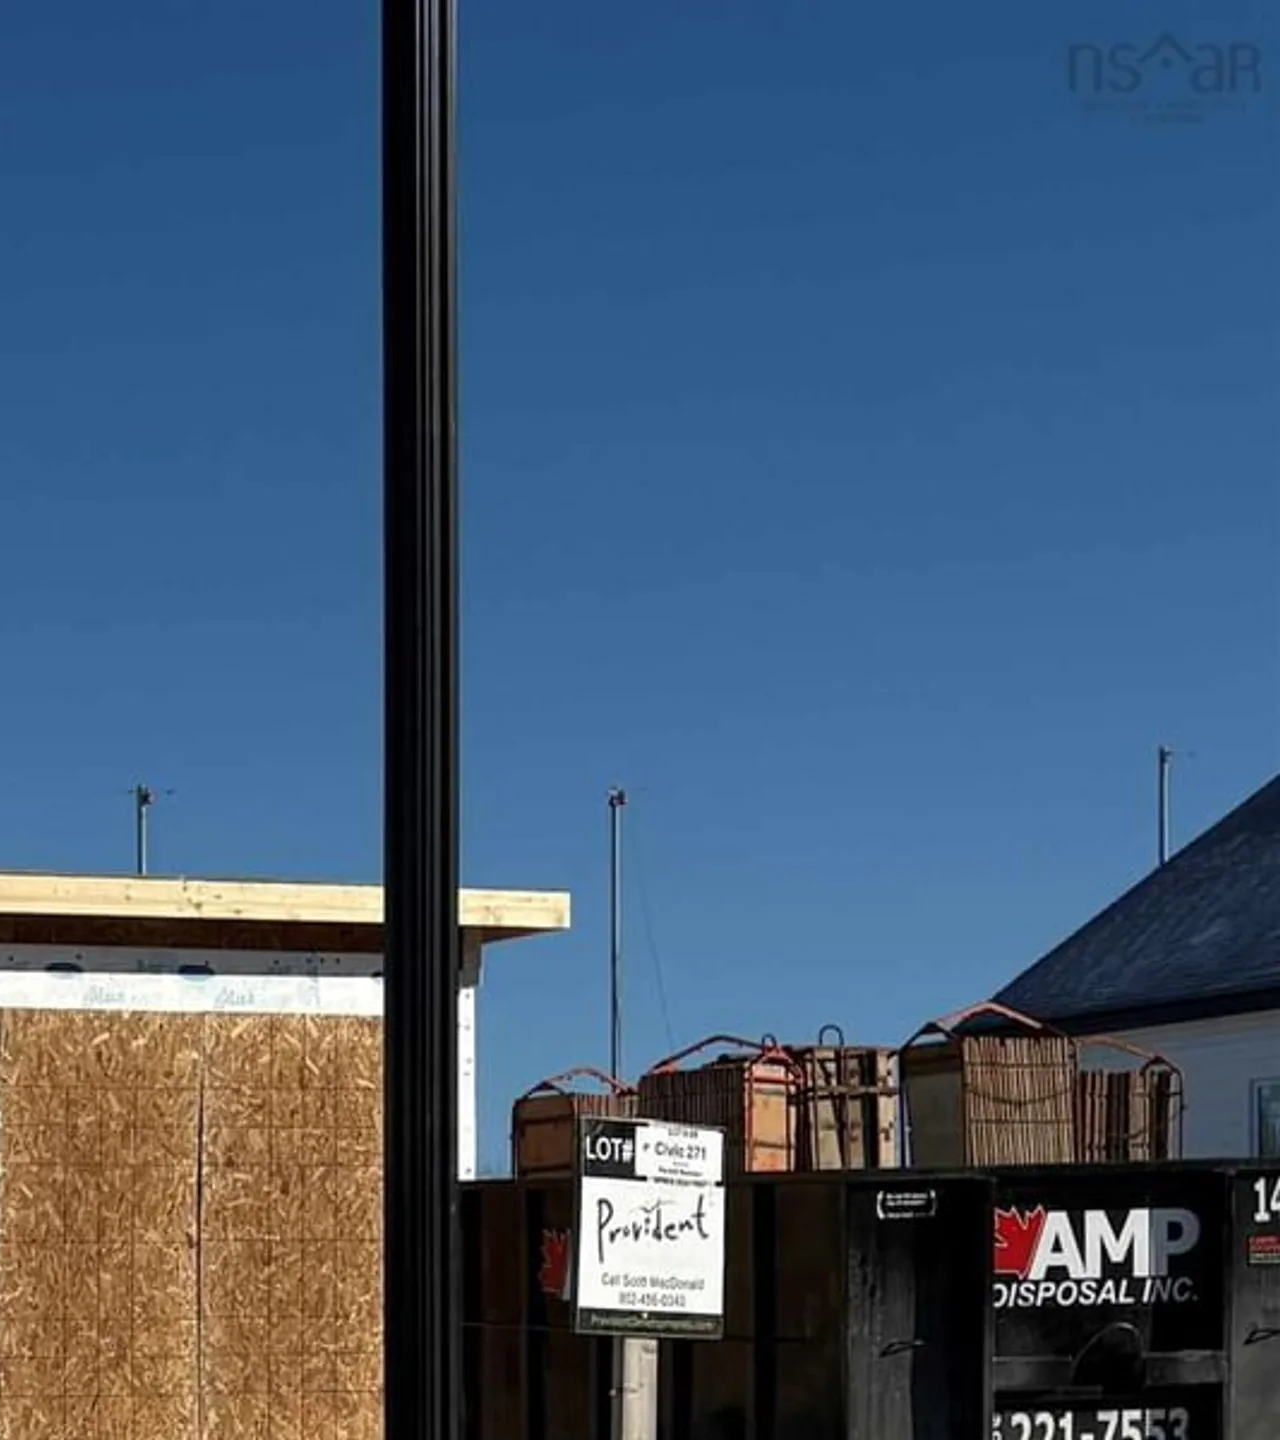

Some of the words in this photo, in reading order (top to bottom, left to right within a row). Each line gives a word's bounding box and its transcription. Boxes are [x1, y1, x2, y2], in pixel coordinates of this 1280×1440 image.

[586, 1134, 634, 1163] LOT#
[596, 1194, 709, 1264] Provident
[1028, 1207, 1201, 1280] AMP
[1142, 1277, 1199, 1304] INC.
